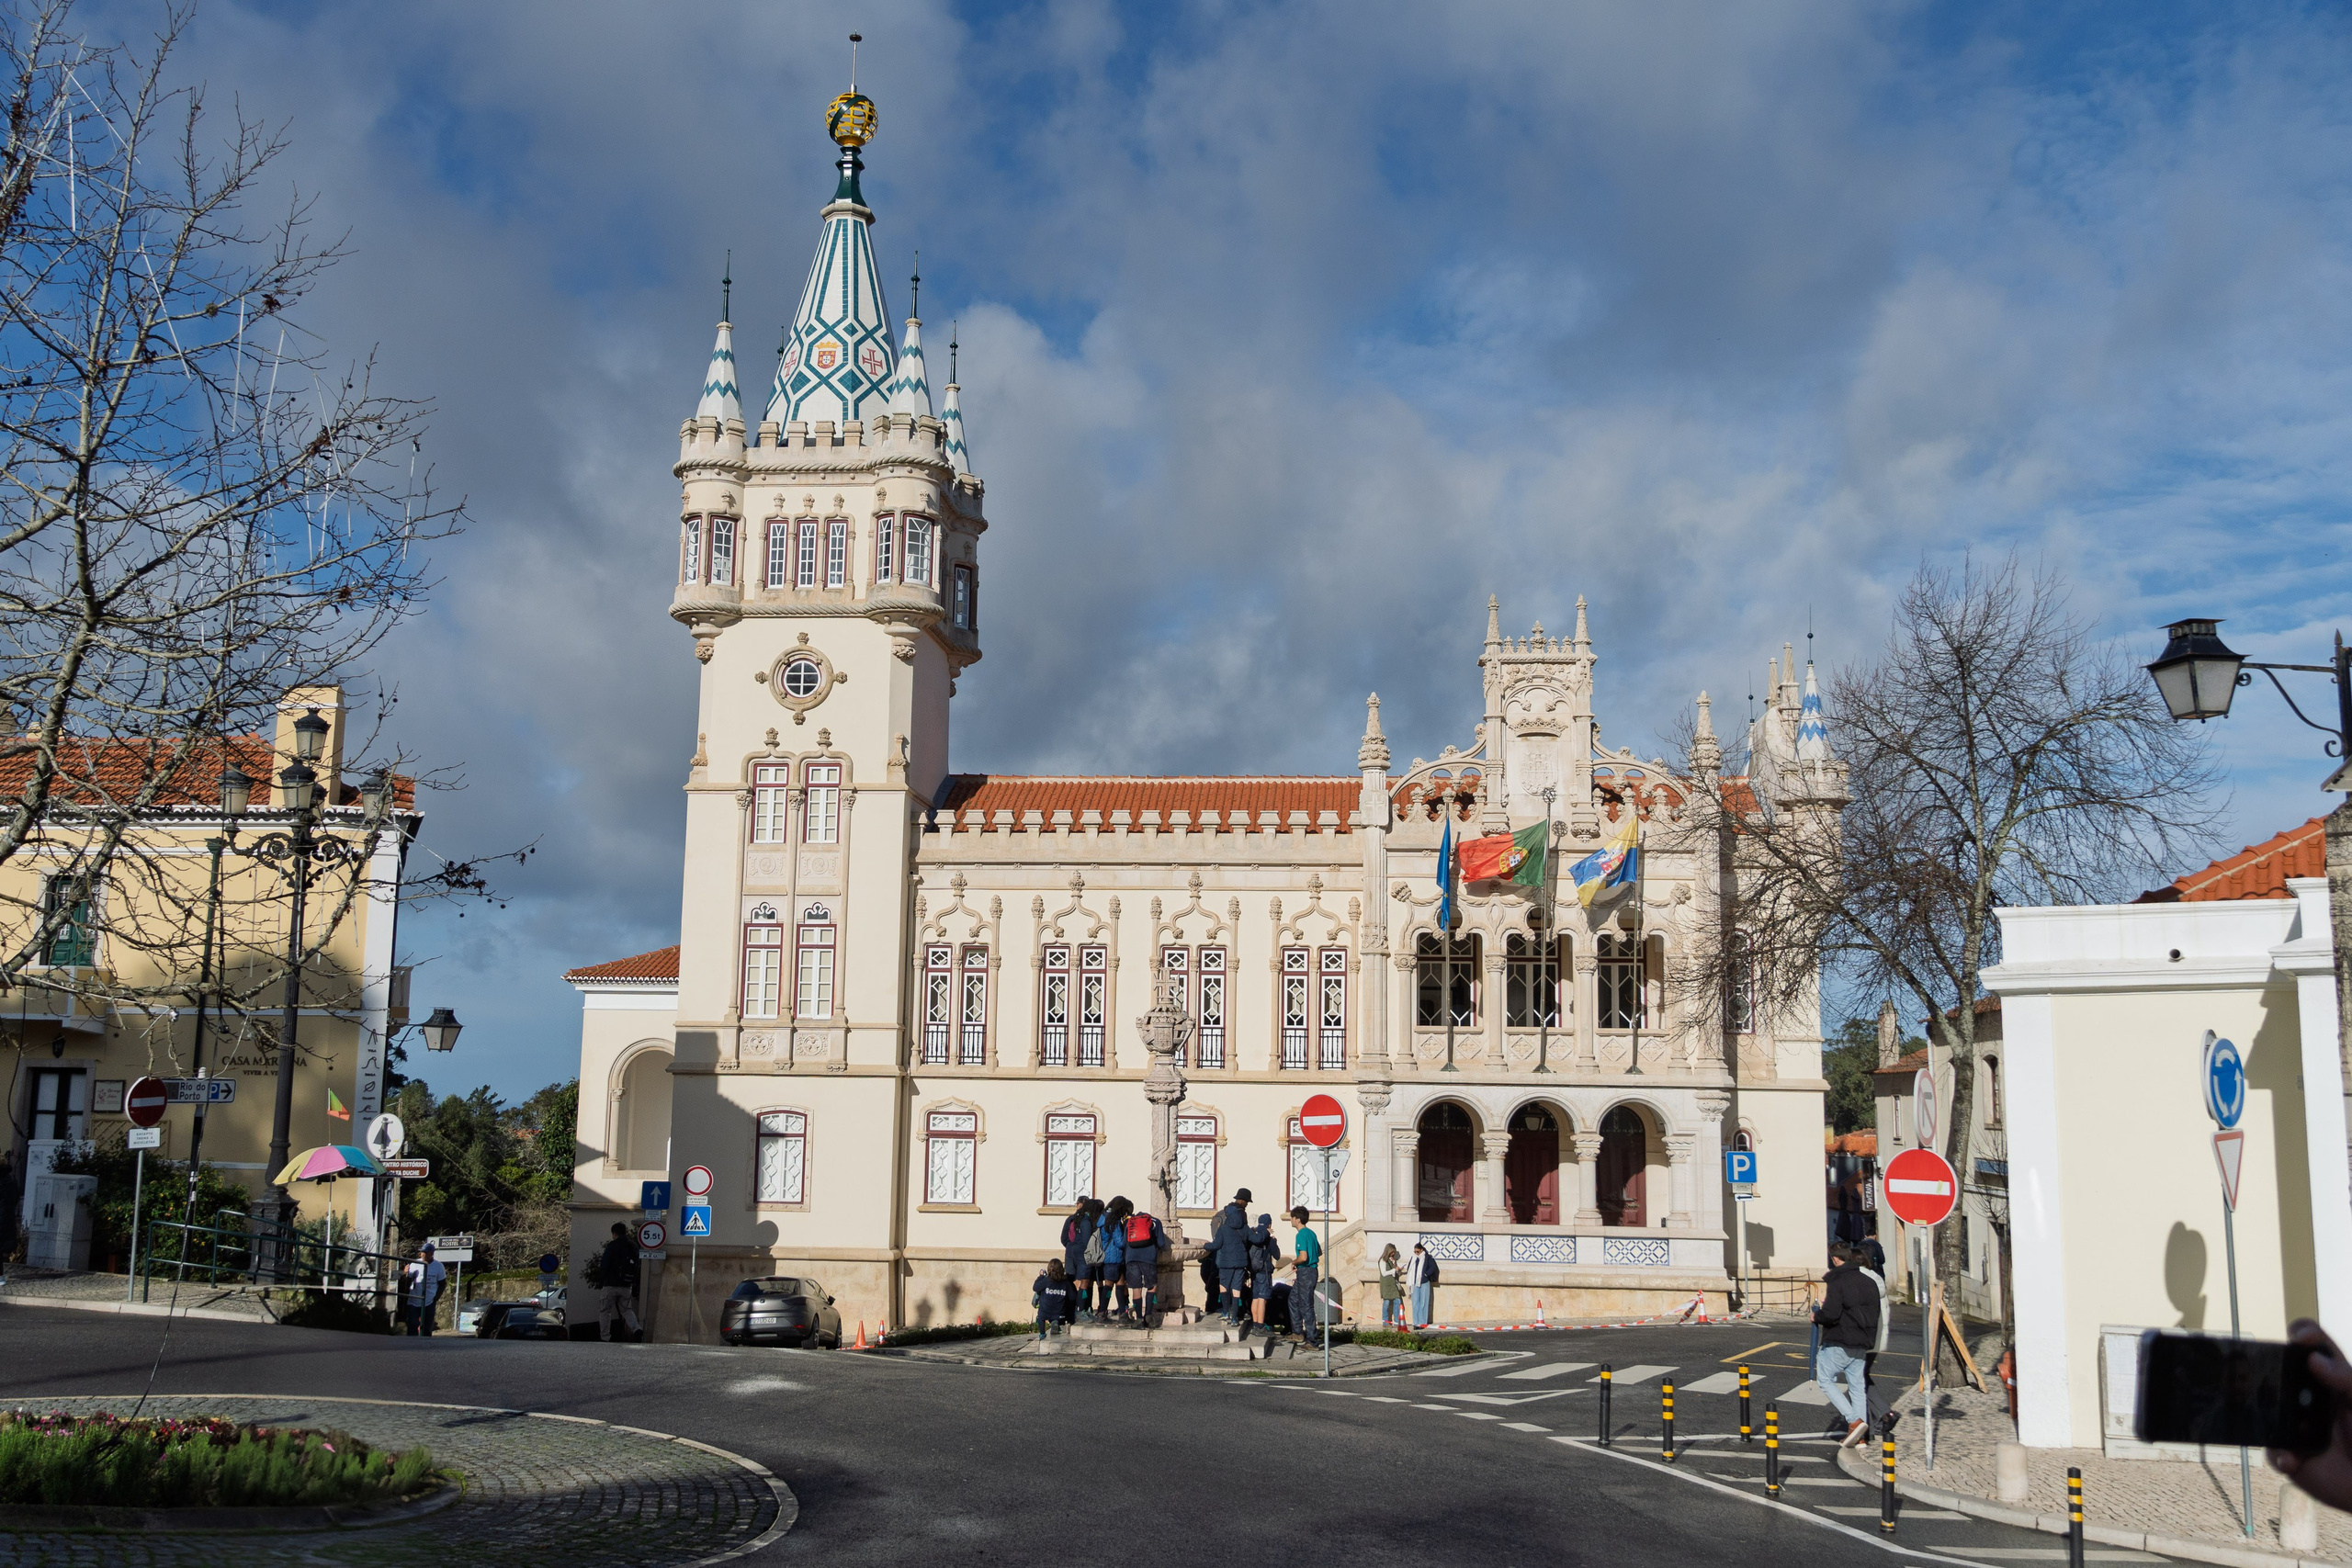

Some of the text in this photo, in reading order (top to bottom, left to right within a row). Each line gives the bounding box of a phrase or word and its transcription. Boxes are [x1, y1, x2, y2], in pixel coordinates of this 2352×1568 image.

[221, 1055, 308, 1066] CASA MARNA
[180, 1082, 193, 1091] Rio
[196, 1082, 206, 1091] do
[179, 1091, 201, 1100] Porto
[1733, 1155, 1750, 1180] P
[1865, 1182, 1873, 1209] TAVERNA
[1046, 1287, 1066, 1296] Scouts
